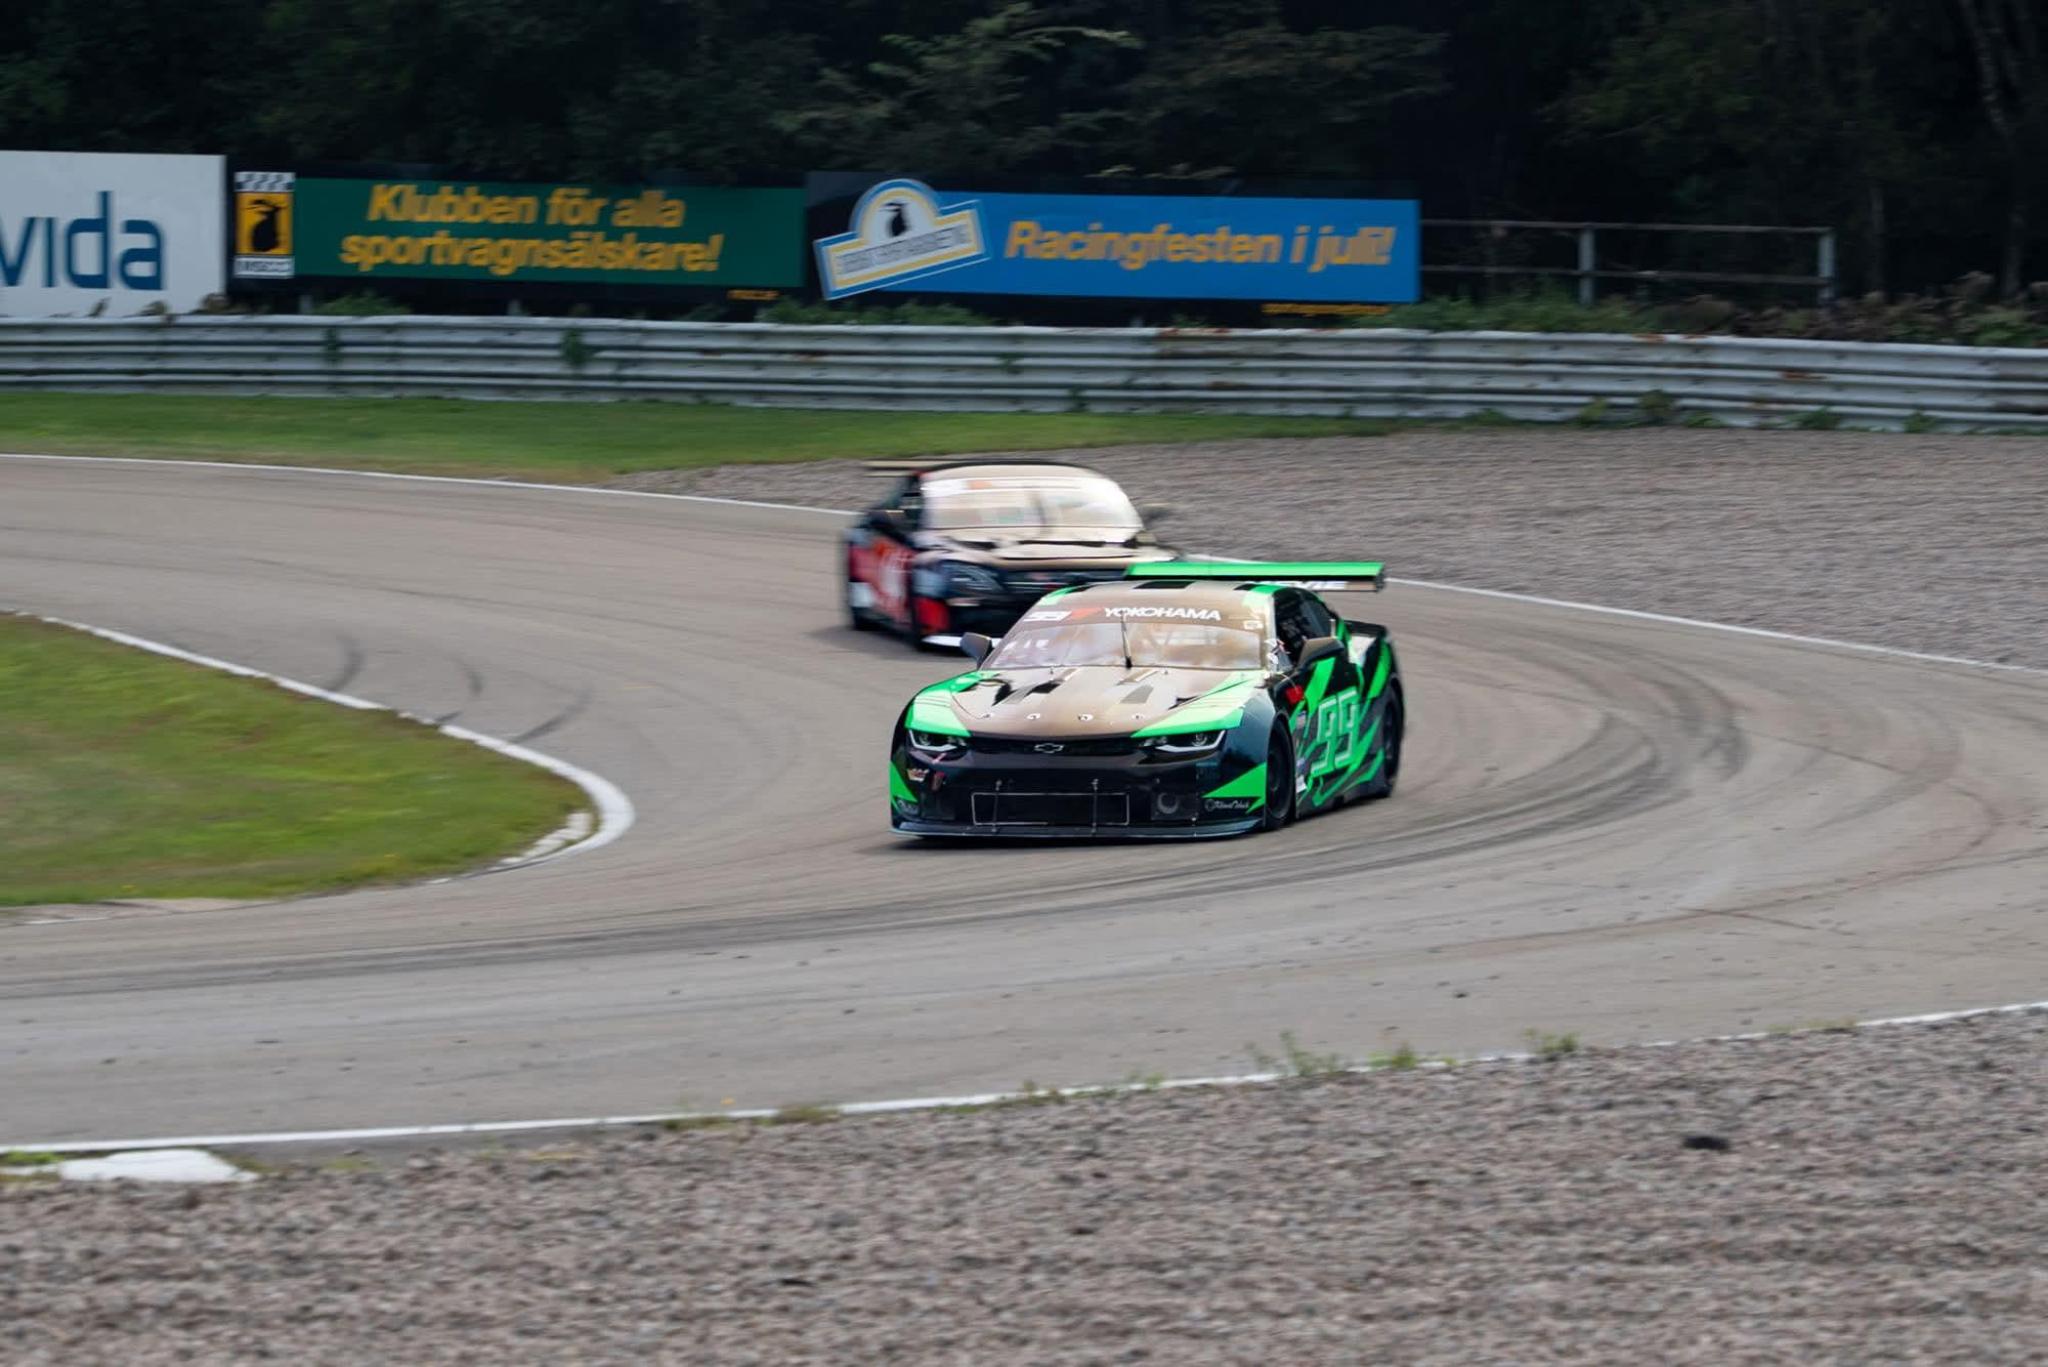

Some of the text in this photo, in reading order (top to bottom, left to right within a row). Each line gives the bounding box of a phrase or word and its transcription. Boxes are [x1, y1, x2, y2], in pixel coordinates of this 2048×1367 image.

[367, 184, 686, 228] Klubben för alla
[0, 191, 164, 290] vida
[340, 231, 724, 276] sportvagnsälskare!
[1004, 219, 1281, 271] Racingfesten
[1293, 227, 1309, 263] i
[1310, 227, 1396, 272] juli!
[1104, 606, 1221, 621] YOKOHAMA
[1310, 686, 1359, 778] 99
